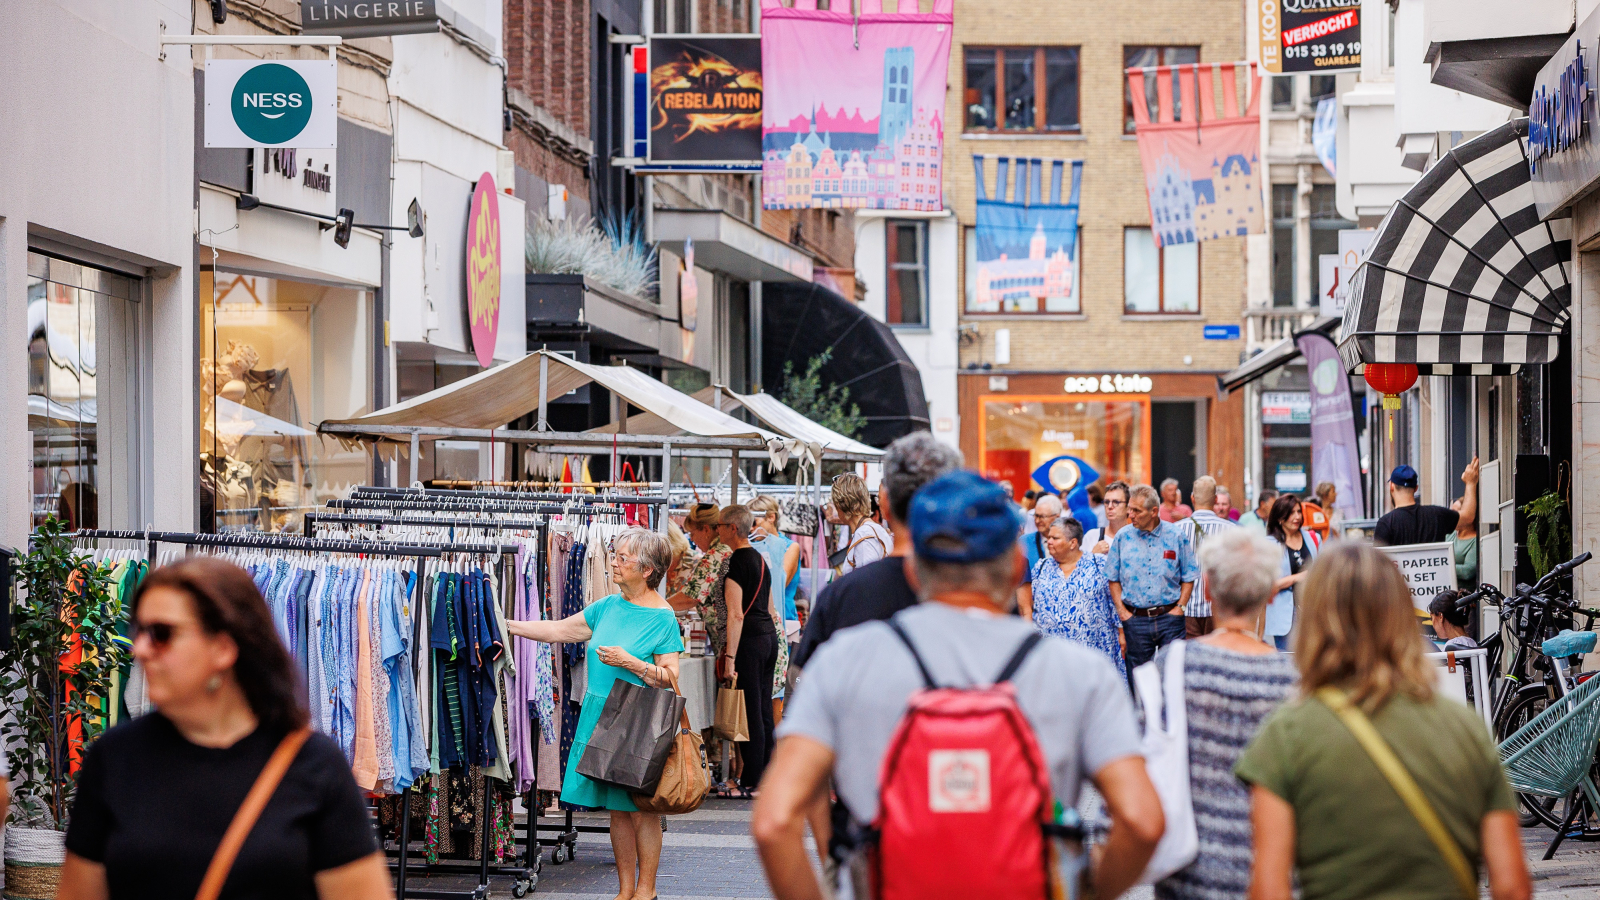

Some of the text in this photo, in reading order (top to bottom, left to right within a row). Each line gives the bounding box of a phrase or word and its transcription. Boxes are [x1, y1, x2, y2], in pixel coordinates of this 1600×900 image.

[1261, 0, 1277, 67] TE KOO
[1283, 11, 1354, 46] VERKOCHT
[1285, 41, 1361, 58] 015 33 19 19
[243, 92, 303, 108] NESS
[664, 91, 760, 109] REBELATION
[1402, 557, 1449, 569] PAPIER
[1414, 572, 1437, 582] SET
[1409, 585, 1452, 597] RONEN
